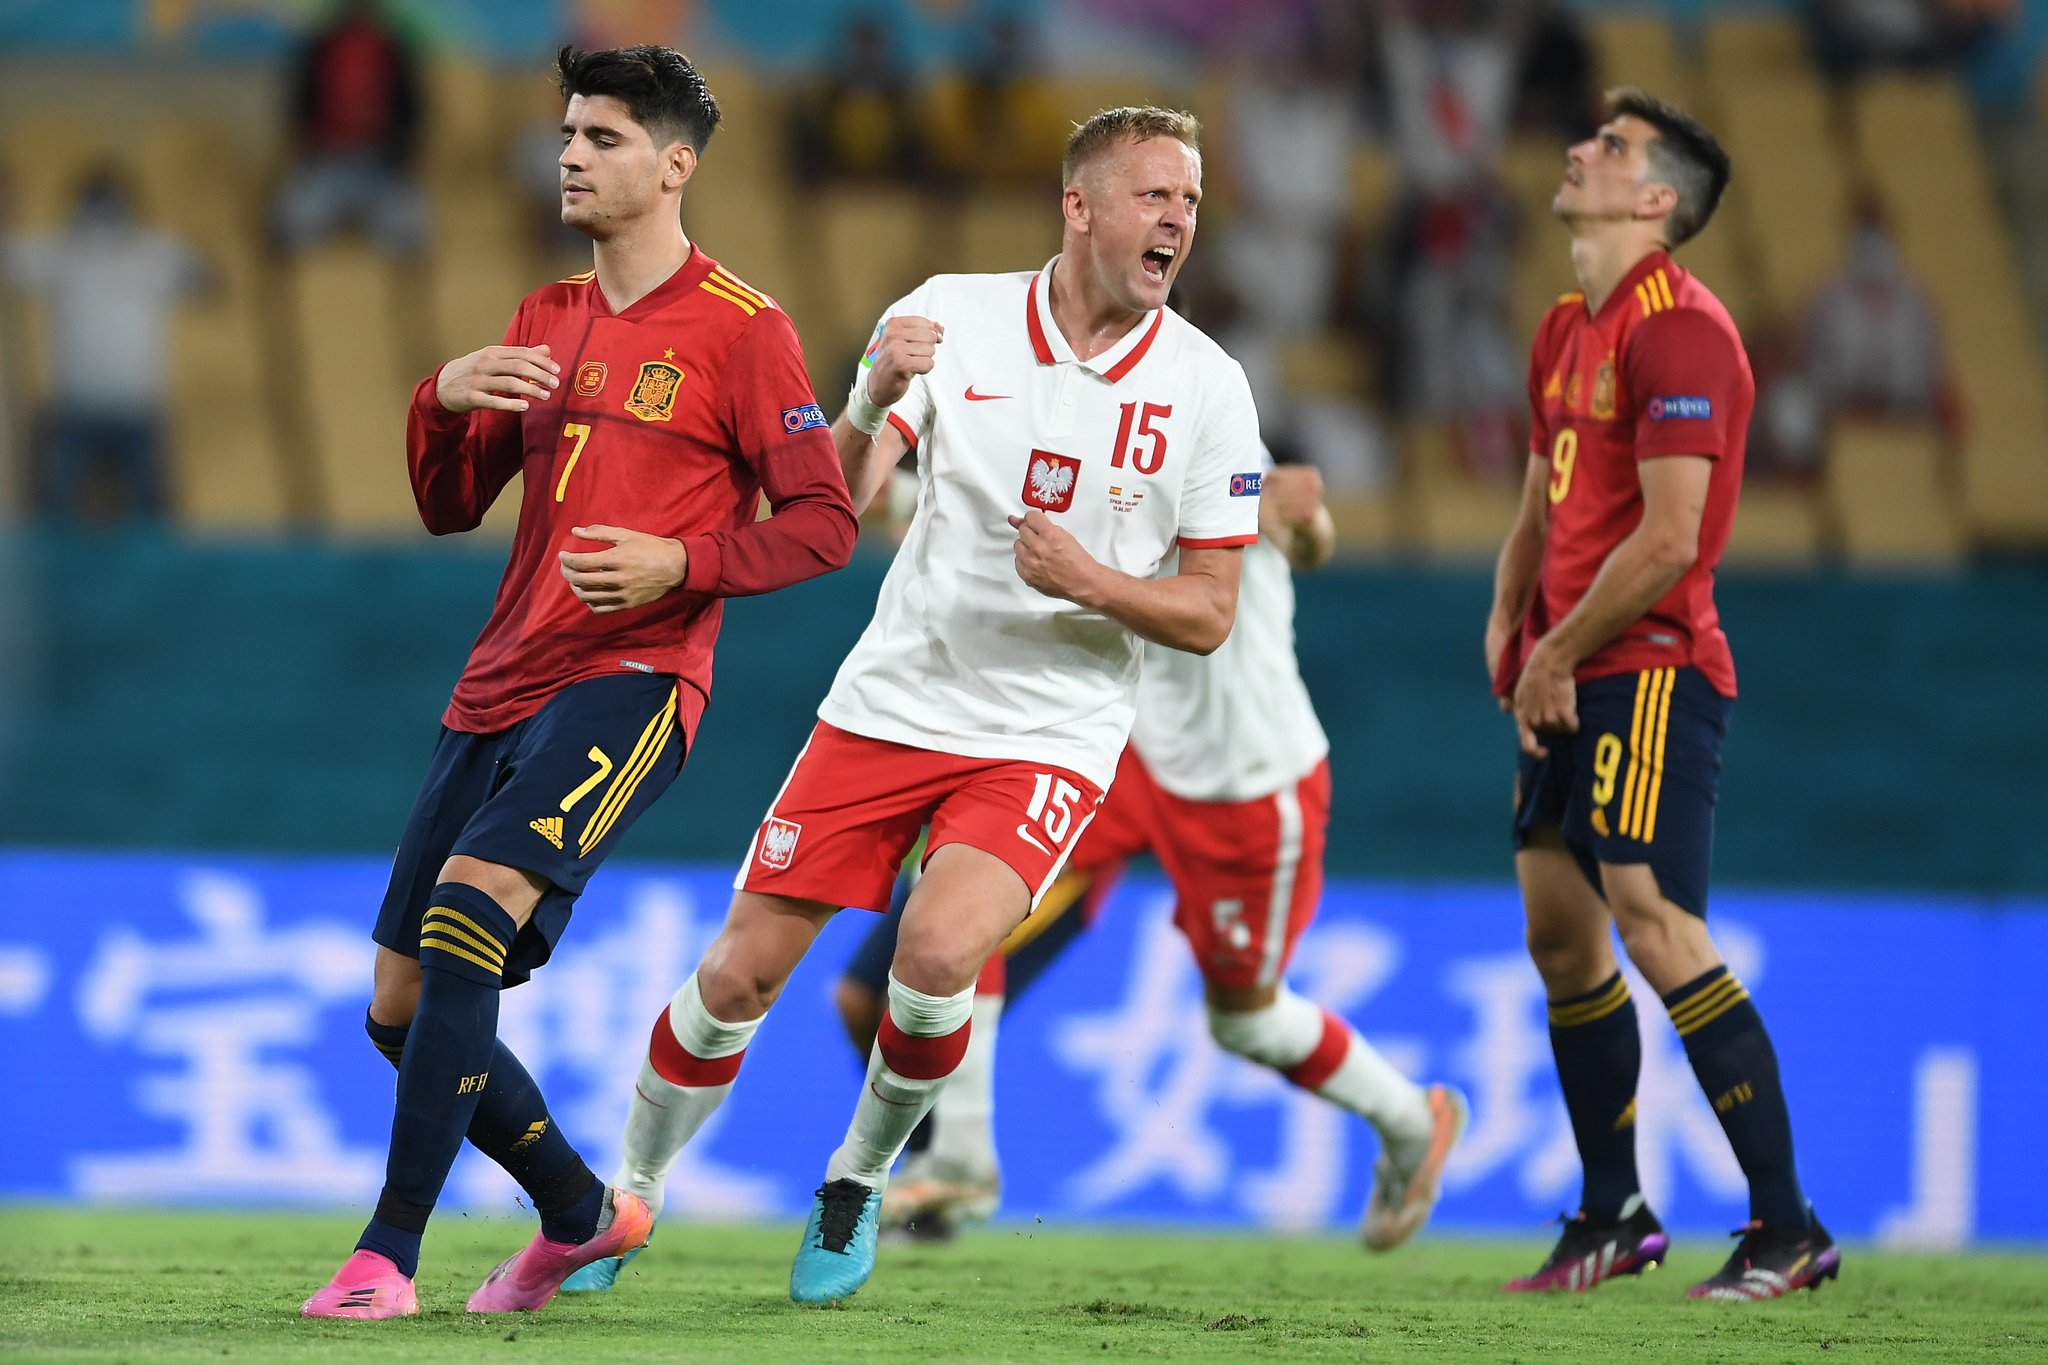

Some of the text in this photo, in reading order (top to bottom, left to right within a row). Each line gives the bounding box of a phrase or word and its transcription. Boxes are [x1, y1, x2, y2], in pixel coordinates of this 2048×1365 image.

[555, 422, 592, 503] 7
[1110, 400, 1172, 475] 15
[1549, 427, 1578, 504] 9
[559, 745, 613, 813] 7
[1592, 731, 1623, 807] 9
[529, 820, 564, 850] adidas
[1026, 772, 1082, 844] 15
